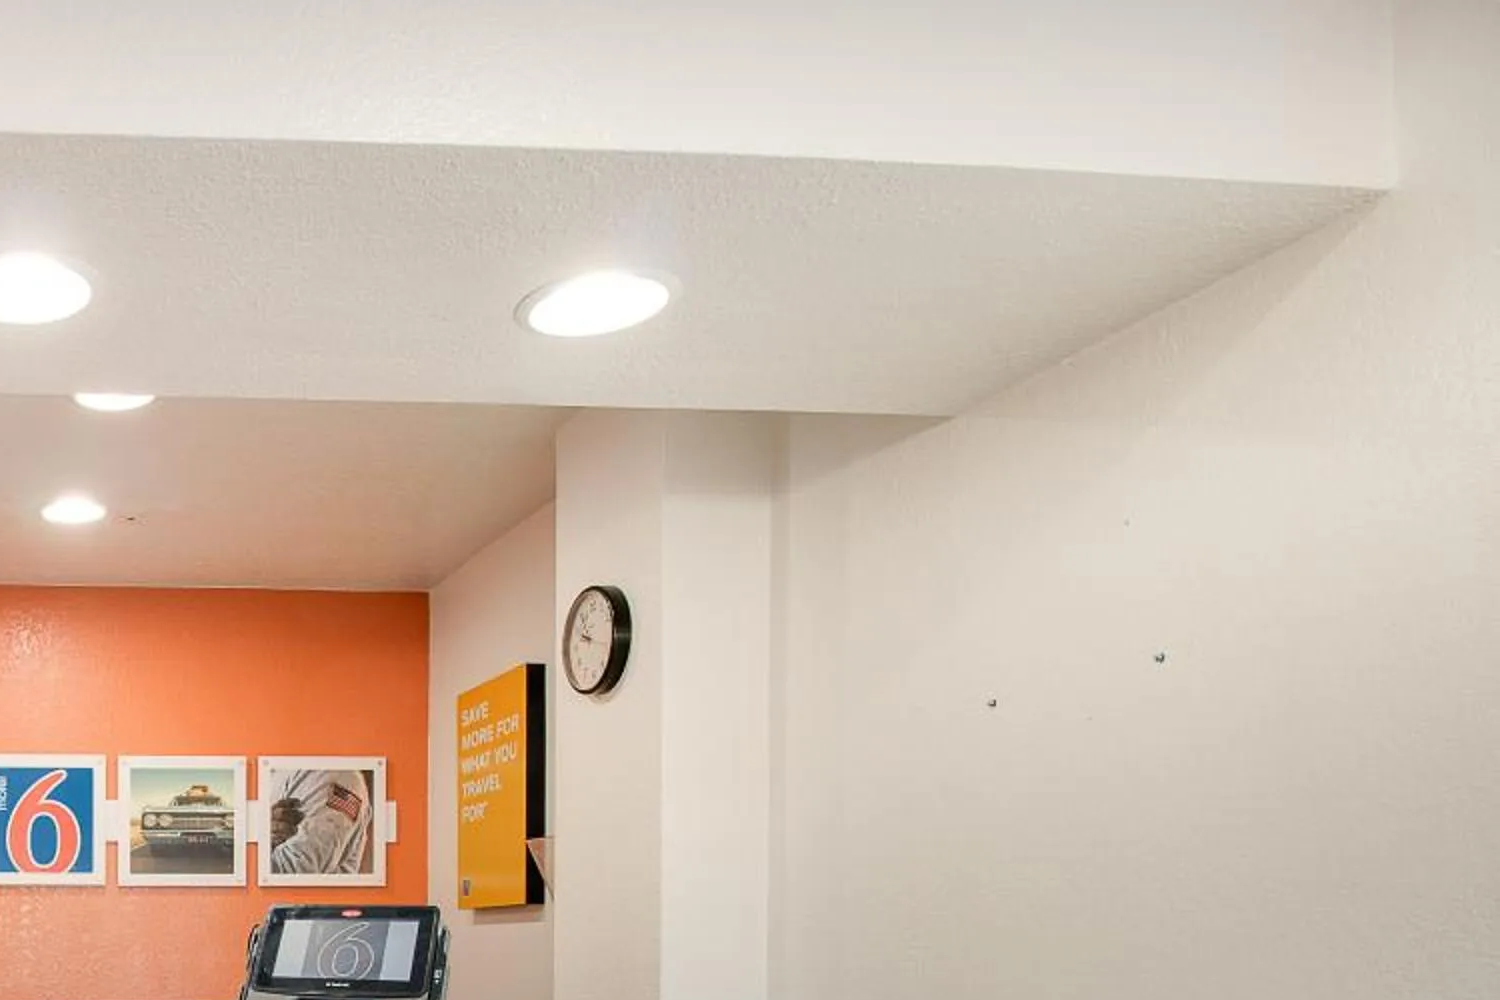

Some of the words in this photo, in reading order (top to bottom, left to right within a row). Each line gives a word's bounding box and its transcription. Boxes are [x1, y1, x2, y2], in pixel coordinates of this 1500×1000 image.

[461, 701, 489, 726] SAVE
[461, 724, 494, 750] MORE
[496, 713, 519, 738] FOR
[462, 751, 490, 775] WHAT
[495, 740, 517, 764] YOU
[462, 773, 502, 797] TRAVEL
[6, 769, 81, 873] 6
